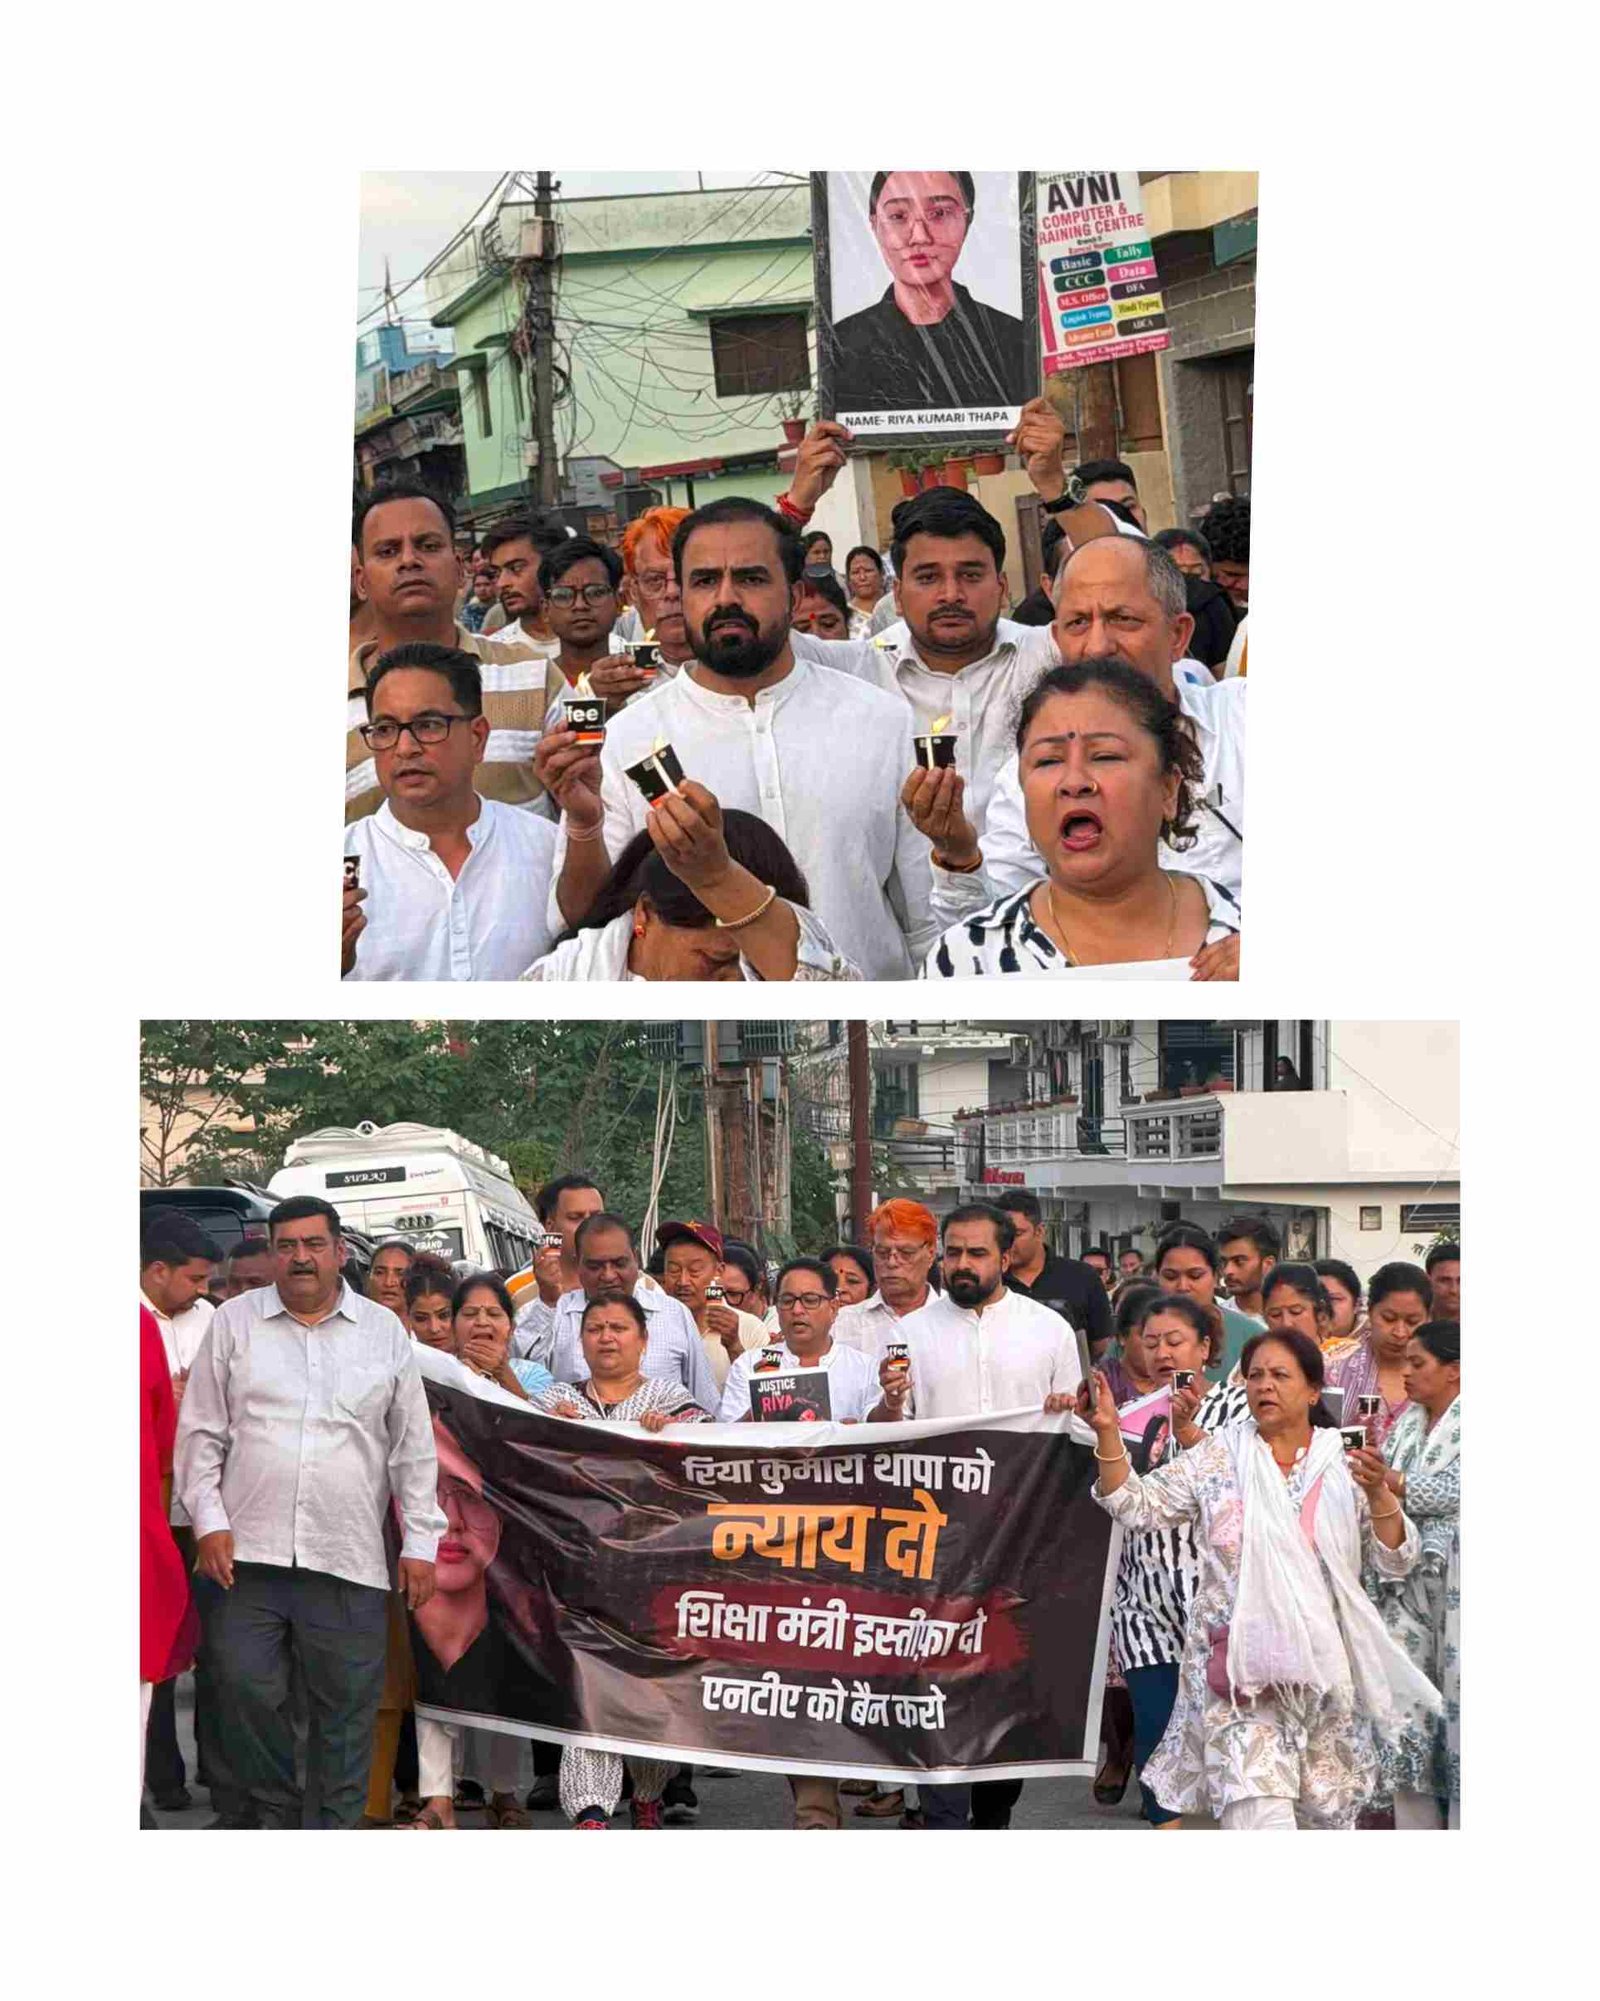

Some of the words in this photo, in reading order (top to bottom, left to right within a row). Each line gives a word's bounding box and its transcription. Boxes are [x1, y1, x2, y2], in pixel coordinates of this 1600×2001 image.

[1048, 172, 1121, 213] AVNI
[1042, 205, 1114, 230] COMPUTER
[1118, 202, 1128, 215] &
[1037, 223, 1092, 245] RAINING
[1095, 213, 1144, 234] CENTRE
[1115, 245, 1144, 259] Tally
[1061, 256, 1093, 270] Basic
[1118, 266, 1147, 279] Data
[1064, 274, 1095, 290] CCC
[845, 415, 885, 426] NAME-
[888, 413, 915, 424] RIYA
[917, 412, 965, 424] KUMARI
[968, 411, 1009, 422] THAPA
[344, 1172, 387, 1183] SURAJ
[757, 1377, 797, 1393] JUSTICE
[761, 1393, 793, 1412] RIYA
[681, 1455, 754, 1486] रिया
[874, 1453, 946, 1489] थापा
[949, 1447, 995, 1495] को
[706, 1502, 876, 1573] न्याय
[881, 1488, 948, 1580] दो
[674, 1590, 772, 1643] शिक्षा
[775, 1597, 850, 1650] मंत्री
[957, 1606, 988, 1653] दो
[701, 1671, 803, 1719] एनटीए
[805, 1678, 849, 1723] को
[850, 1681, 891, 1727] बैन
[891, 1684, 947, 1730] करो
